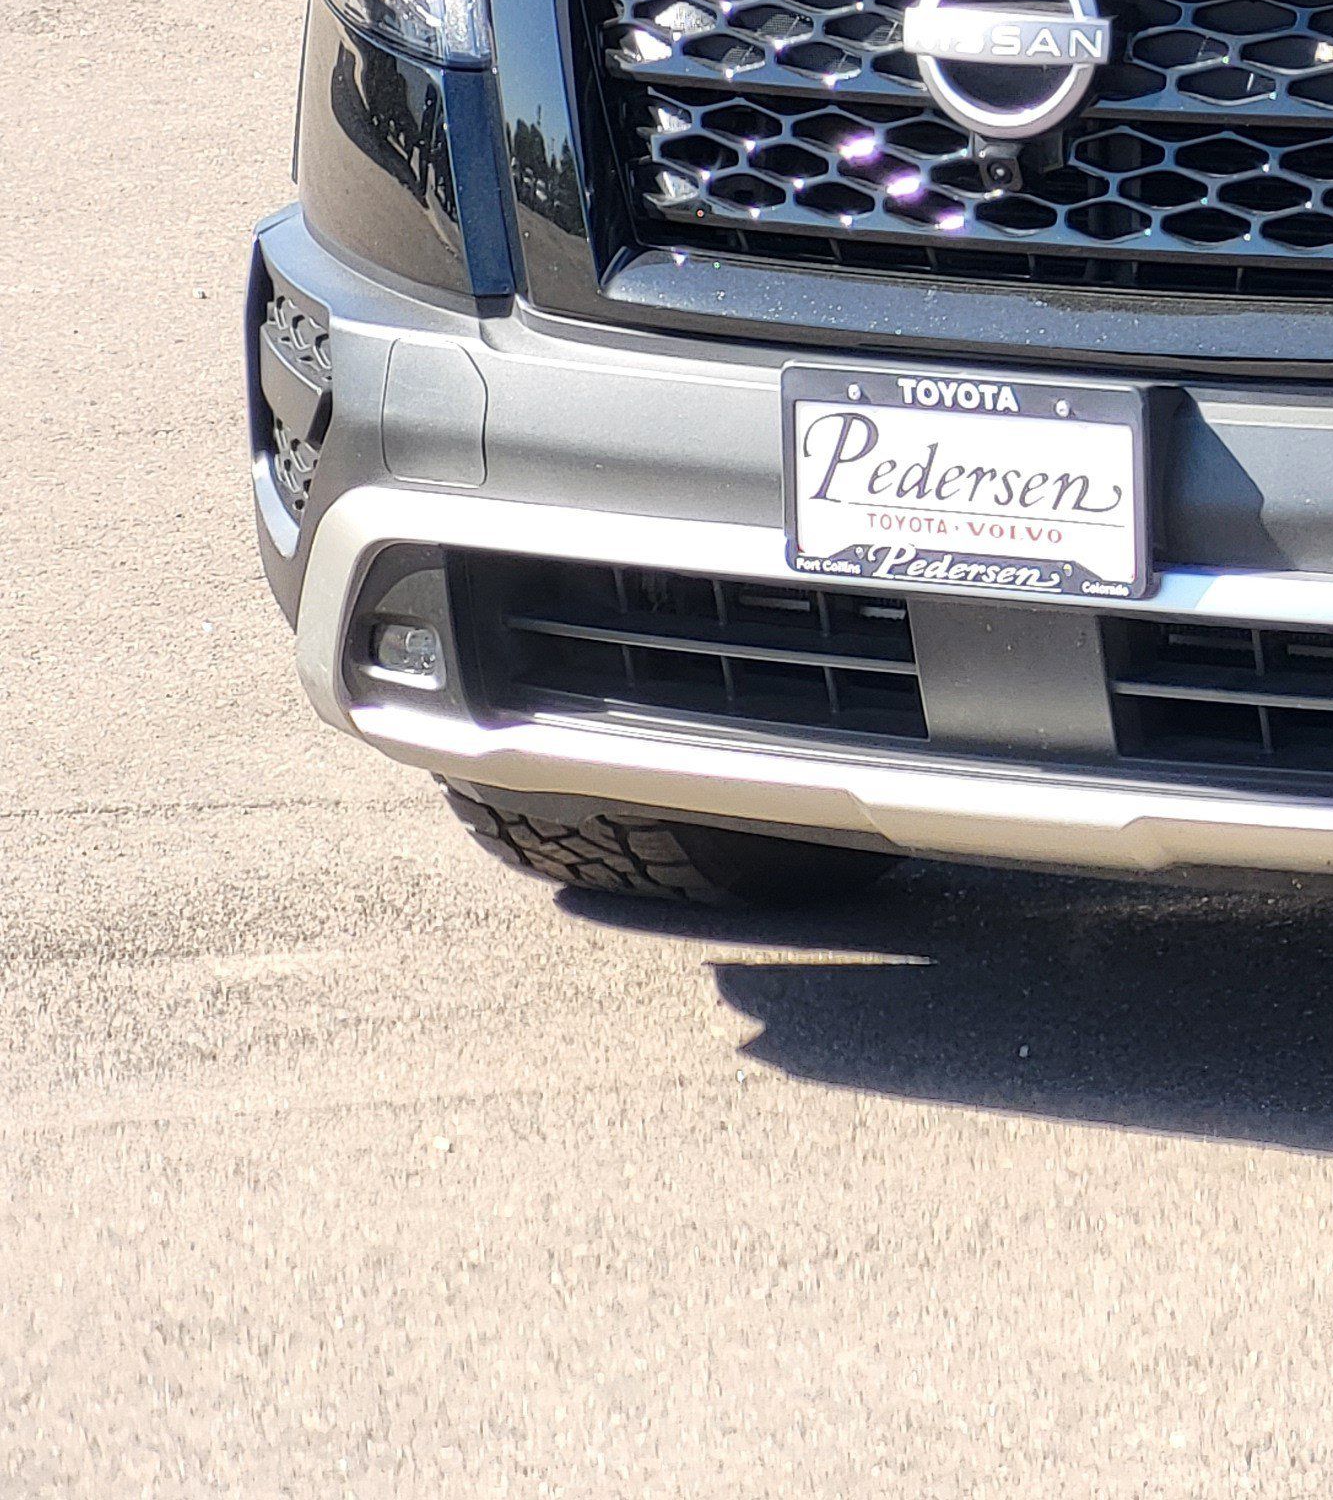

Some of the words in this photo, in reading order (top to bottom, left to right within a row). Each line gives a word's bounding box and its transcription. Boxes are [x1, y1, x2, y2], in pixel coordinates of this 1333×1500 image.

[897, 377, 1020, 413] TOYOTA
[803, 412, 1123, 514] Pedersen
[867, 514, 948, 534] TOYOTA
[966, 521, 1064, 544] VOLVO
[867, 543, 1062, 588] Pedersen
